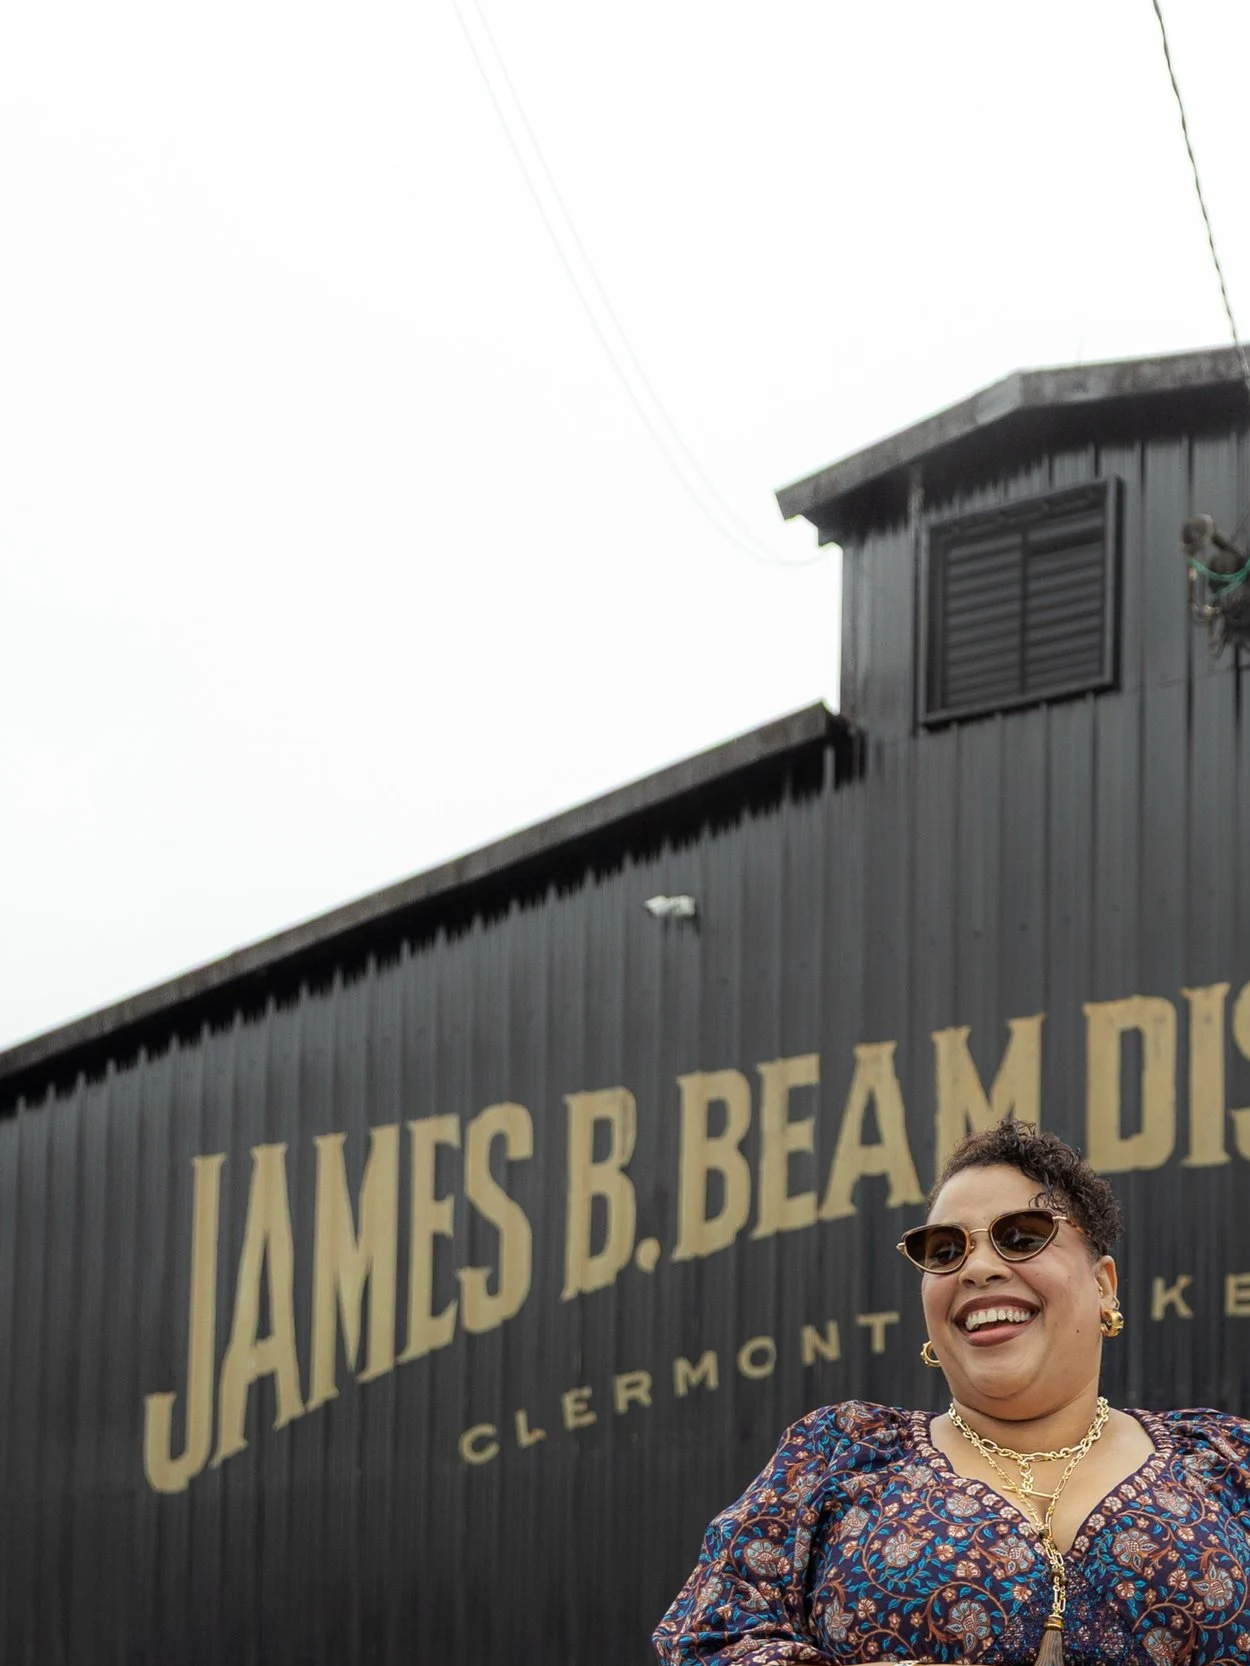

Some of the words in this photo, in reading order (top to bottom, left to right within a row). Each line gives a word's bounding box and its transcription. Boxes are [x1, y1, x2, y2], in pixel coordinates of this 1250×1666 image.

[146, 1103, 533, 1493] JAMES
[563, 1088, 660, 1300] B.
[673, 1012, 1046, 1260] BEAM
[460, 1312, 899, 1464] CLERMONT
